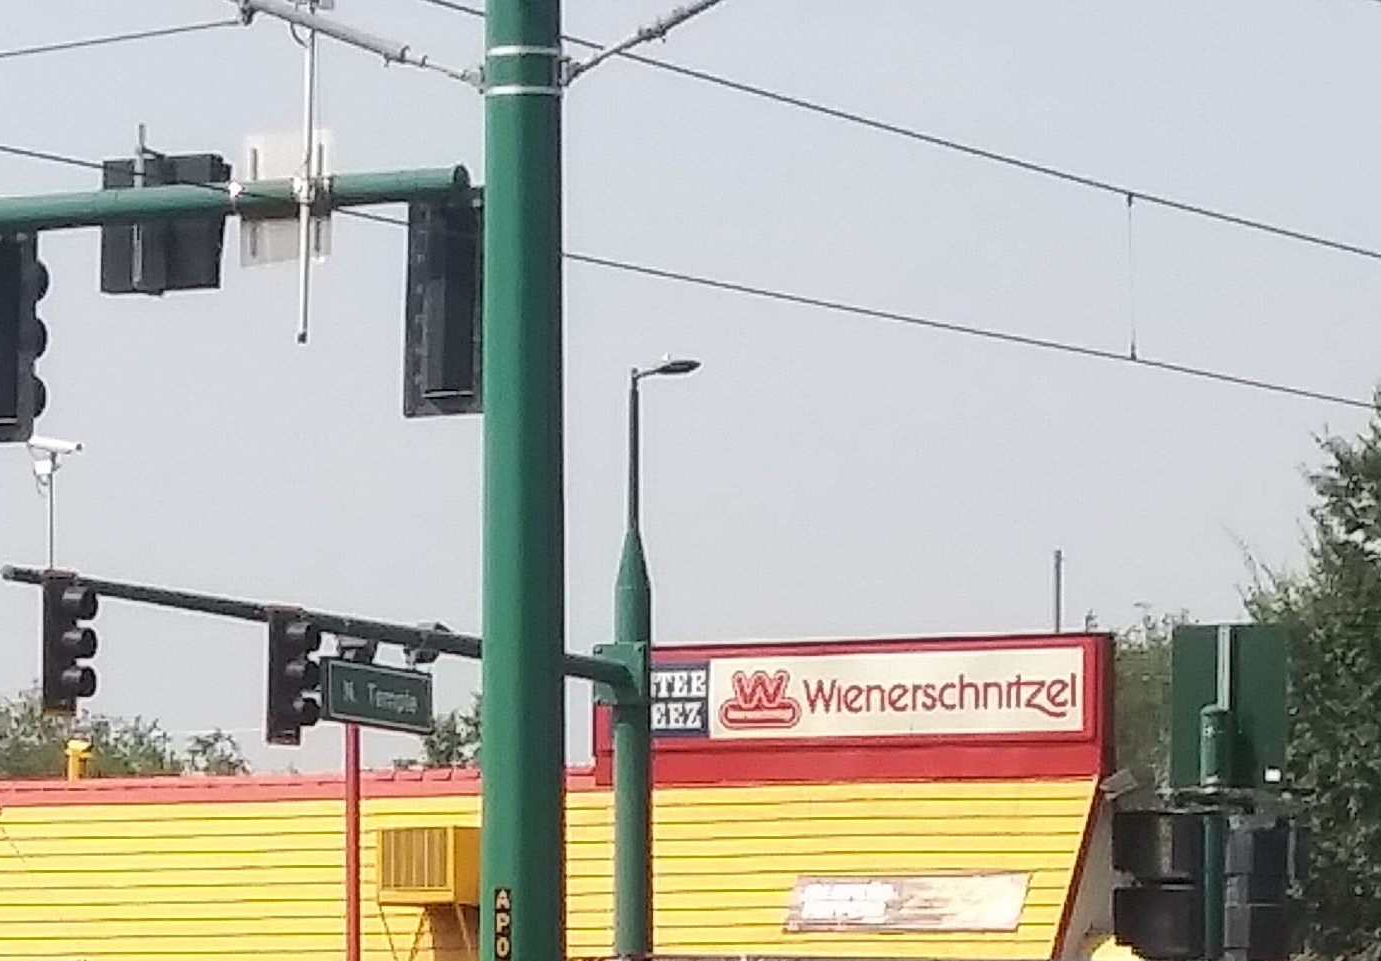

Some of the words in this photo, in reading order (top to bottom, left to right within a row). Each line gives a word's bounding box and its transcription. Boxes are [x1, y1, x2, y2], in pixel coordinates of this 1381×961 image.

[366, 682, 417, 714] Temple
[651, 671, 706, 698] TEE
[803, 672, 1076, 717] Wienerschnitzel
